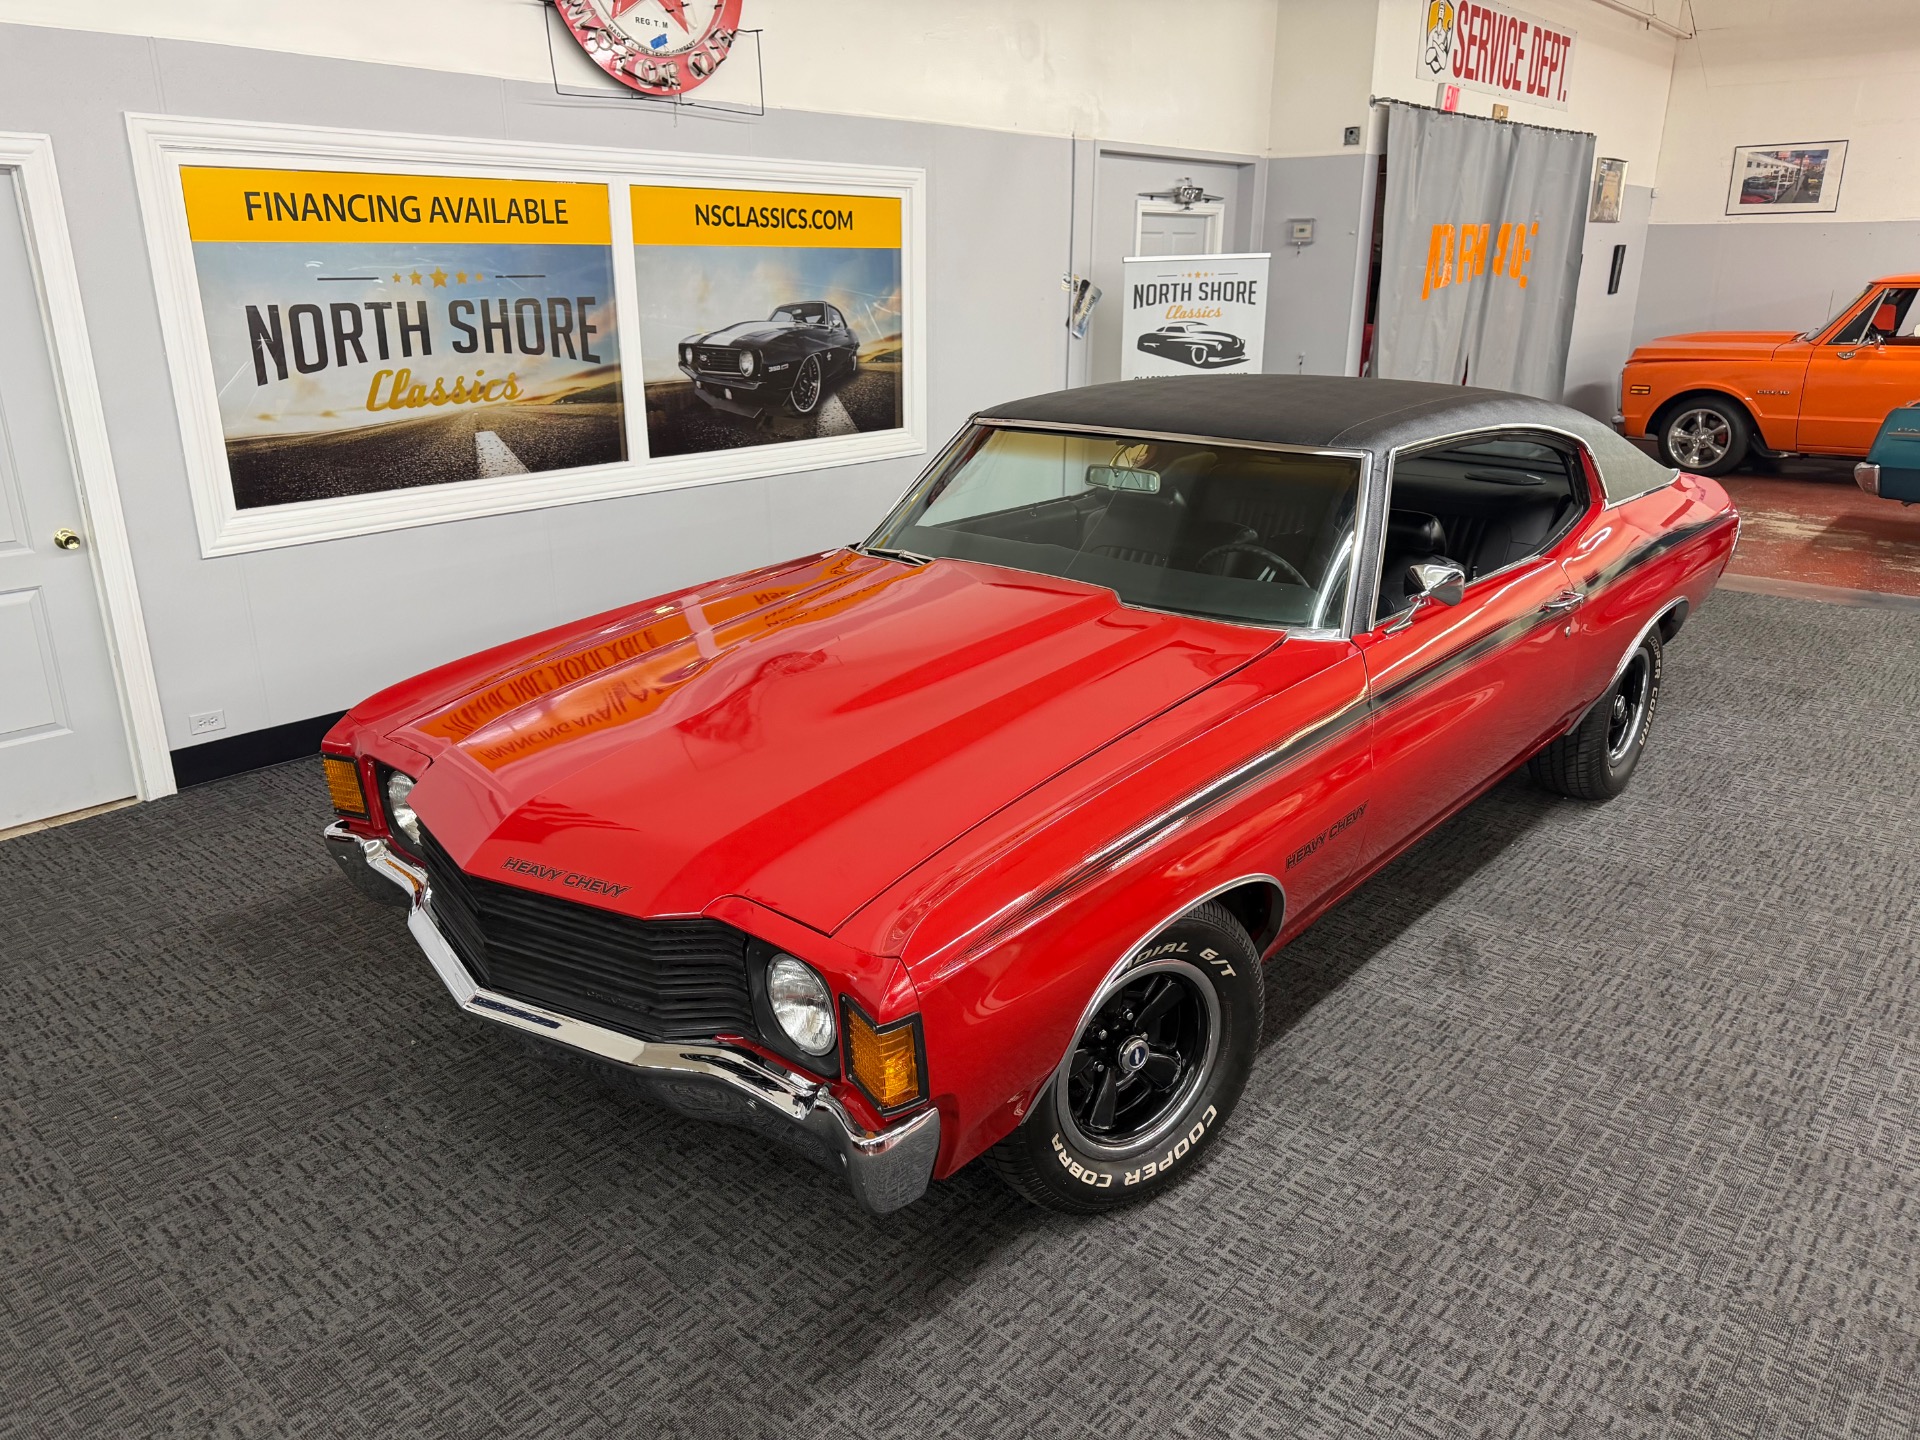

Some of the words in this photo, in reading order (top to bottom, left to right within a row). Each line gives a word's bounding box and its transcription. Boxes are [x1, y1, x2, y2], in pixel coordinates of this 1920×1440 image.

[1452, 0, 1528, 92] SERVICE
[1526, 25, 1571, 102] DEPT.
[243, 191, 421, 223] FINANCING
[429, 196, 569, 225] AVAILABLE
[694, 204, 853, 231] NSCLASSICS.COM
[1133, 282, 1192, 310] NORTH
[1198, 280, 1257, 306] SHORE
[1165, 304, 1222, 320] Classics
[245, 300, 432, 387] NORTH
[448, 296, 601, 365] SHORE
[366, 367, 525, 412] Classics
[1648, 636, 1661, 679] COOPER
[1639, 686, 1658, 746] COBRA
[1285, 827, 1329, 873] HEAVY
[1329, 799, 1369, 840] CHEVY
[501, 857, 567, 881] HEAVY
[563, 873, 632, 898] CHEVY
[1199, 947, 1236, 977] G/T
[1051, 1133, 1112, 1188] COBRA
[1124, 1105, 1217, 1186] COOPER
